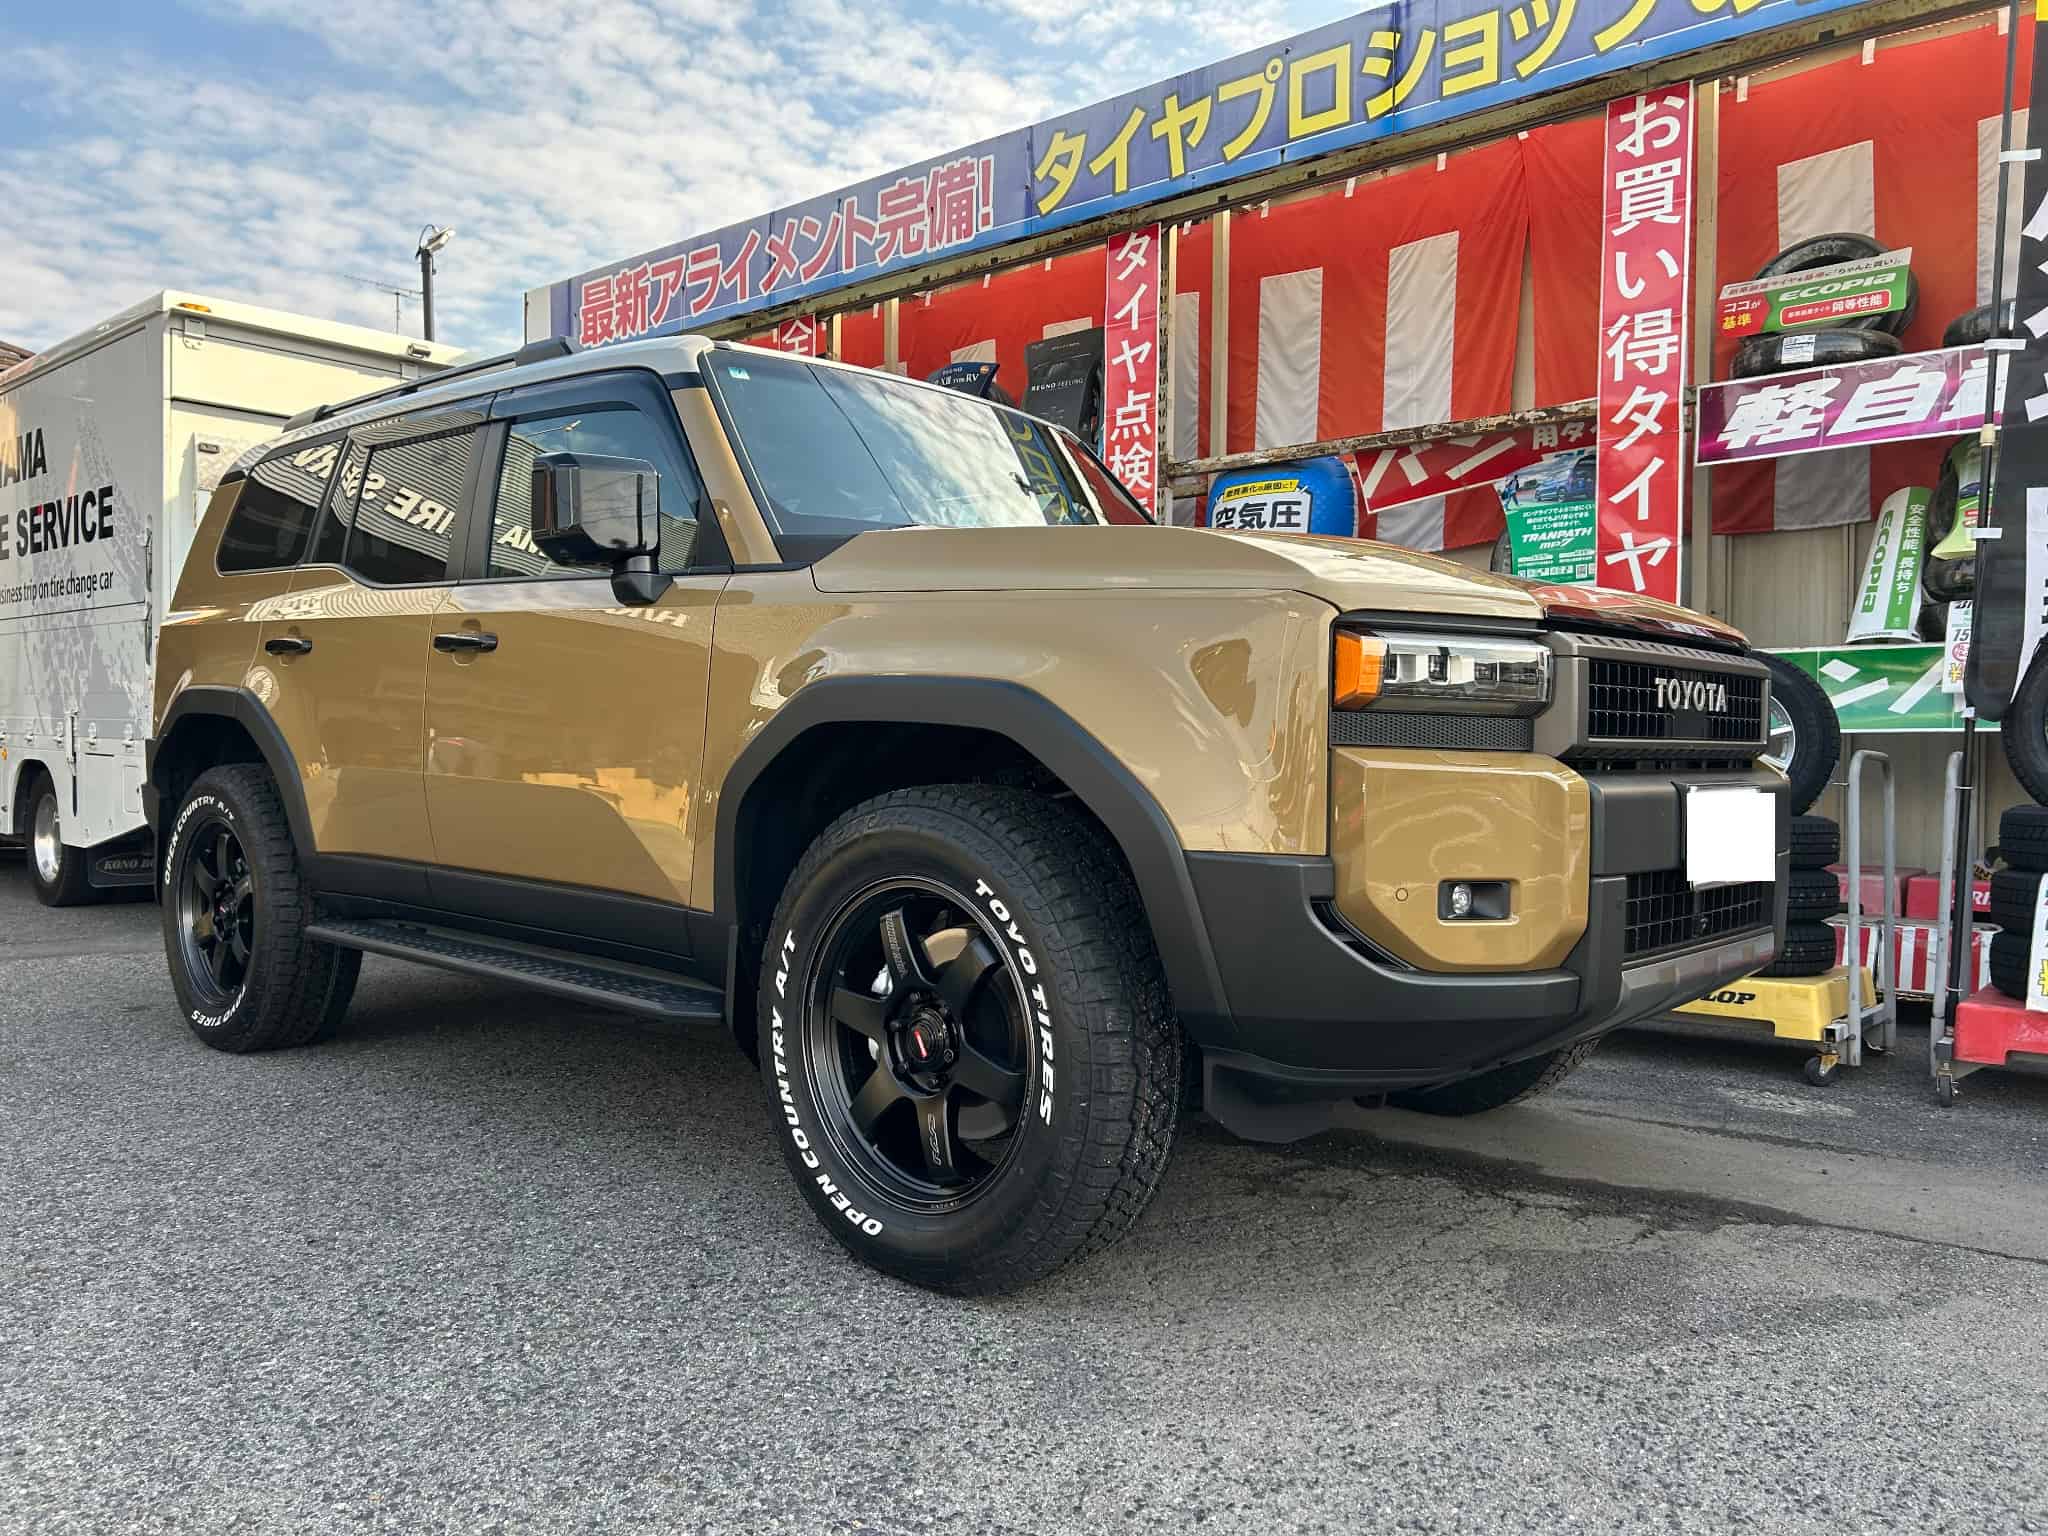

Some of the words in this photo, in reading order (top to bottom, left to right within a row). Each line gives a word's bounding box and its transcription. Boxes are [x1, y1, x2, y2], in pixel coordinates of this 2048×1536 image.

[1723, 313, 1752, 330] 基準
[1605, 94, 1686, 592] お買い得タイヤ
[1031, 382, 1057, 392] REGNO
[16, 485, 114, 557] SERVICE
[1522, 527, 1592, 543] TRANPATH
[24, 578, 37, 607] trip
[39, 581, 49, 600] on
[51, 574, 64, 598] tire
[66, 570, 97, 599] change
[100, 570, 114, 590] car
[1655, 677, 1727, 712] TOYOTA
[177, 795, 215, 833] COUNTRY
[774, 929, 797, 998] A/T
[191, 1008, 222, 1028] TIRES
[975, 877, 1039, 975] TOYO
[1031, 983, 1054, 1127] TIRES
[771, 1006, 821, 1169] COUNTRY
[816, 1172, 885, 1236] OPEN
